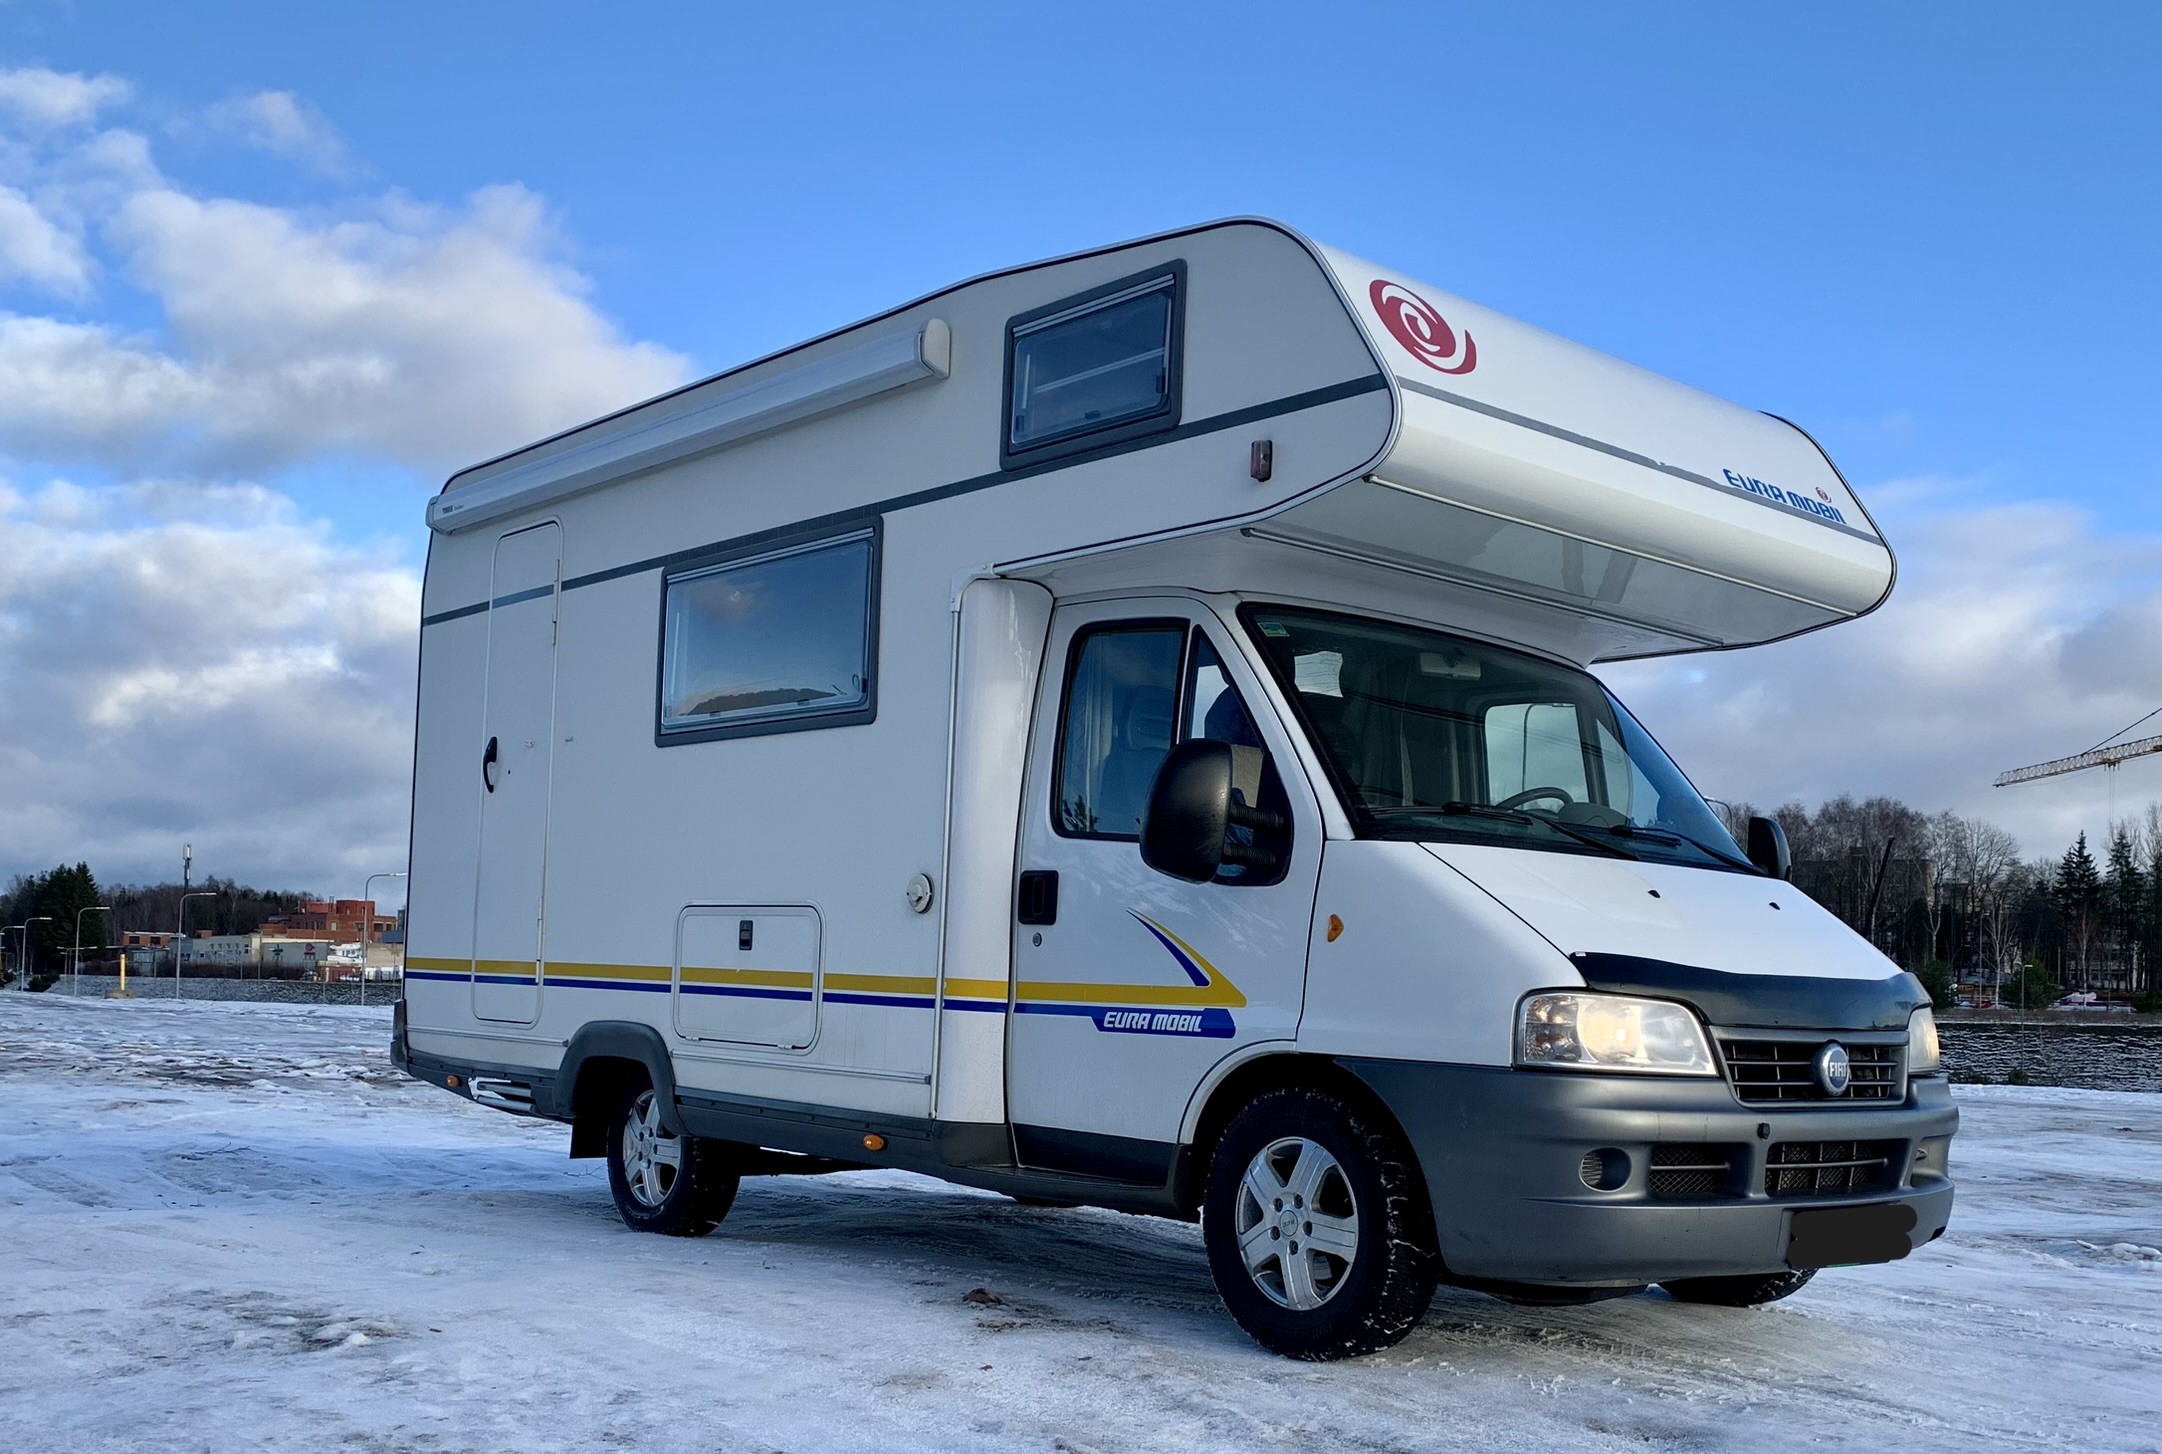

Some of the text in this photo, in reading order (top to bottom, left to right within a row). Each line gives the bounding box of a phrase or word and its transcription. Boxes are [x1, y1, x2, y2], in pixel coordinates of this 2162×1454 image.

[1723, 468, 1847, 525] EURA MOBIL
[1103, 1012, 1203, 1033] EURA MOBIL
[1829, 1062, 1847, 1077] FIAT
